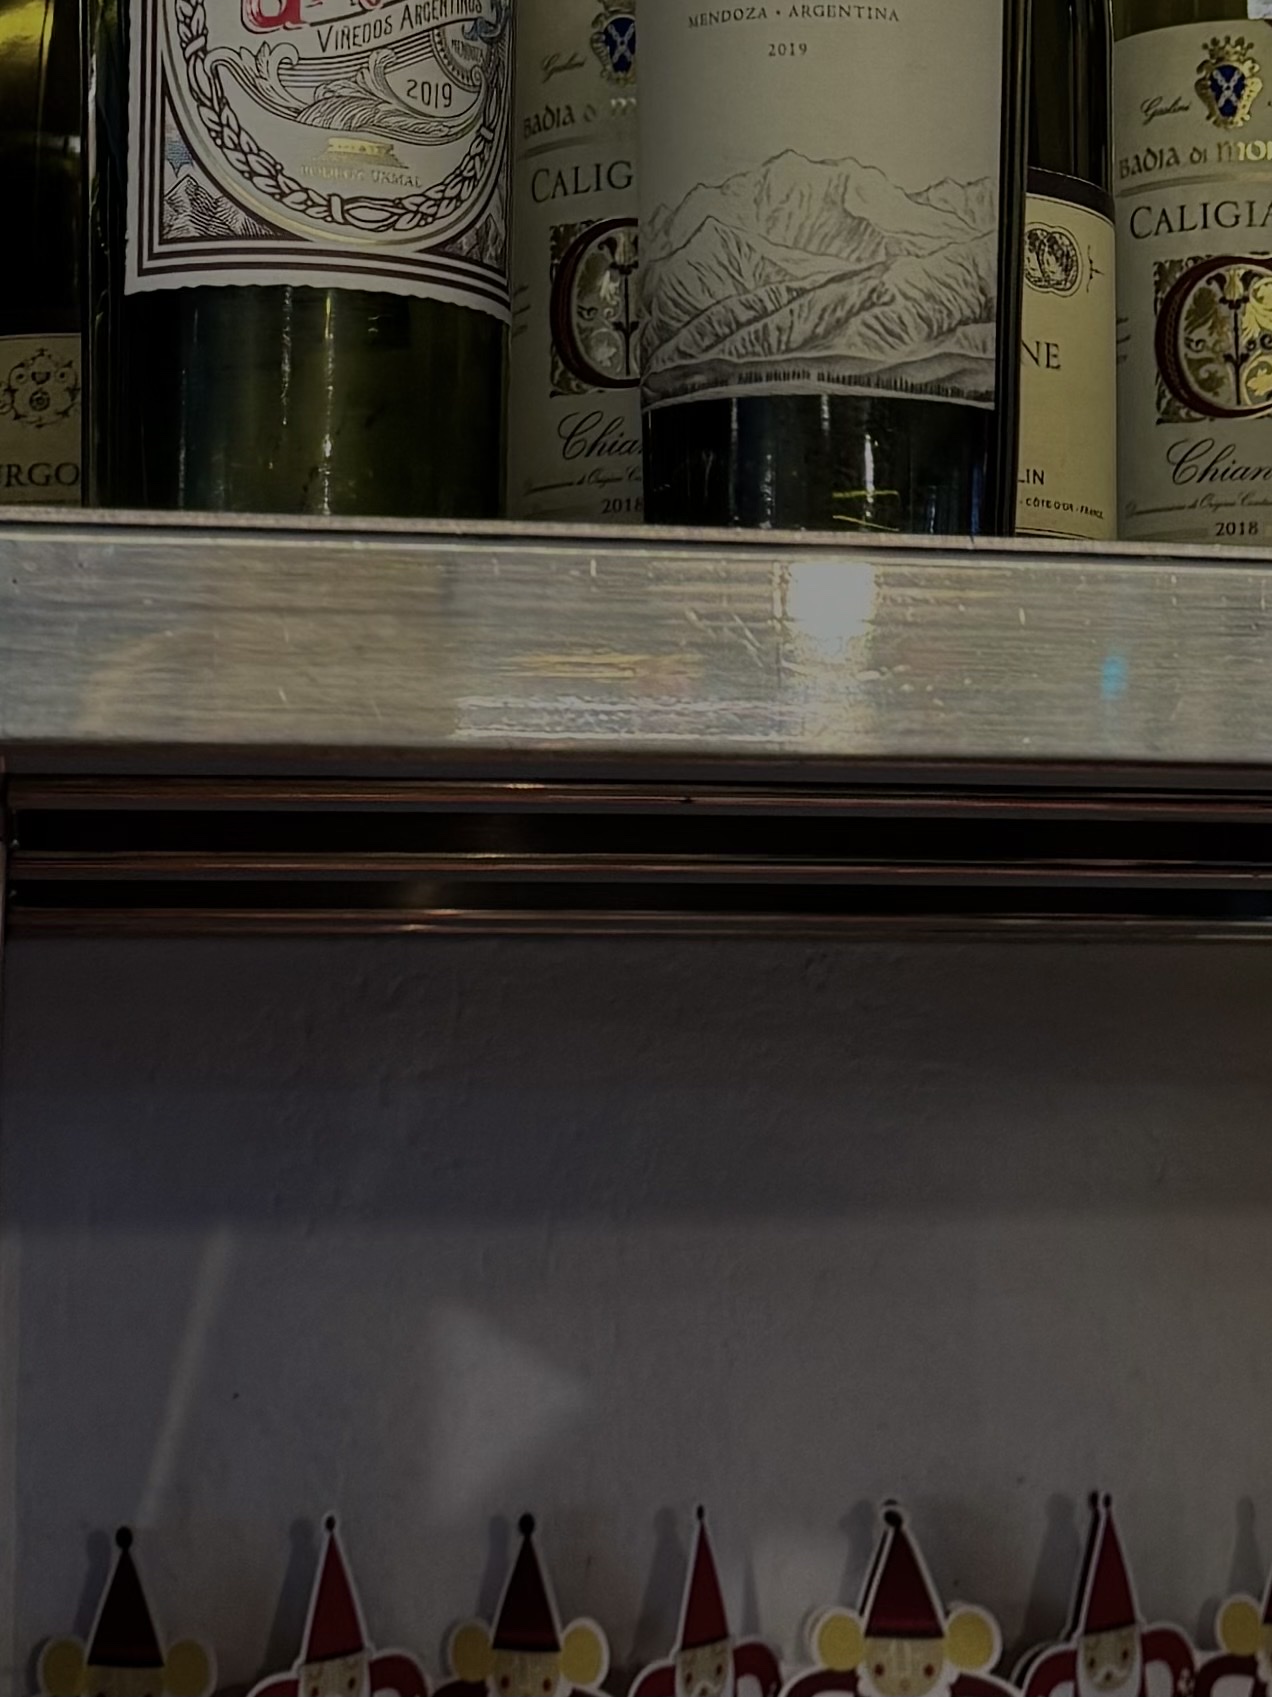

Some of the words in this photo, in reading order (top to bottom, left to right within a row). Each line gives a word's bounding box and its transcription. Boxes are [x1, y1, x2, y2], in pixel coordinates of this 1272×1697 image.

[688, 7, 767, 28] MENDOZA
[788, 4, 899, 22] ARGENTINA
[768, 42, 808, 57] 2019
[406, 79, 452, 108] 2019
[530, 160, 634, 204] CALIG
[1020, 341, 1062, 370] NE
[557, 410, 641, 460] Chia
[0, 462, 80, 488] RGO
[1215, 520, 1259, 537] 2018
